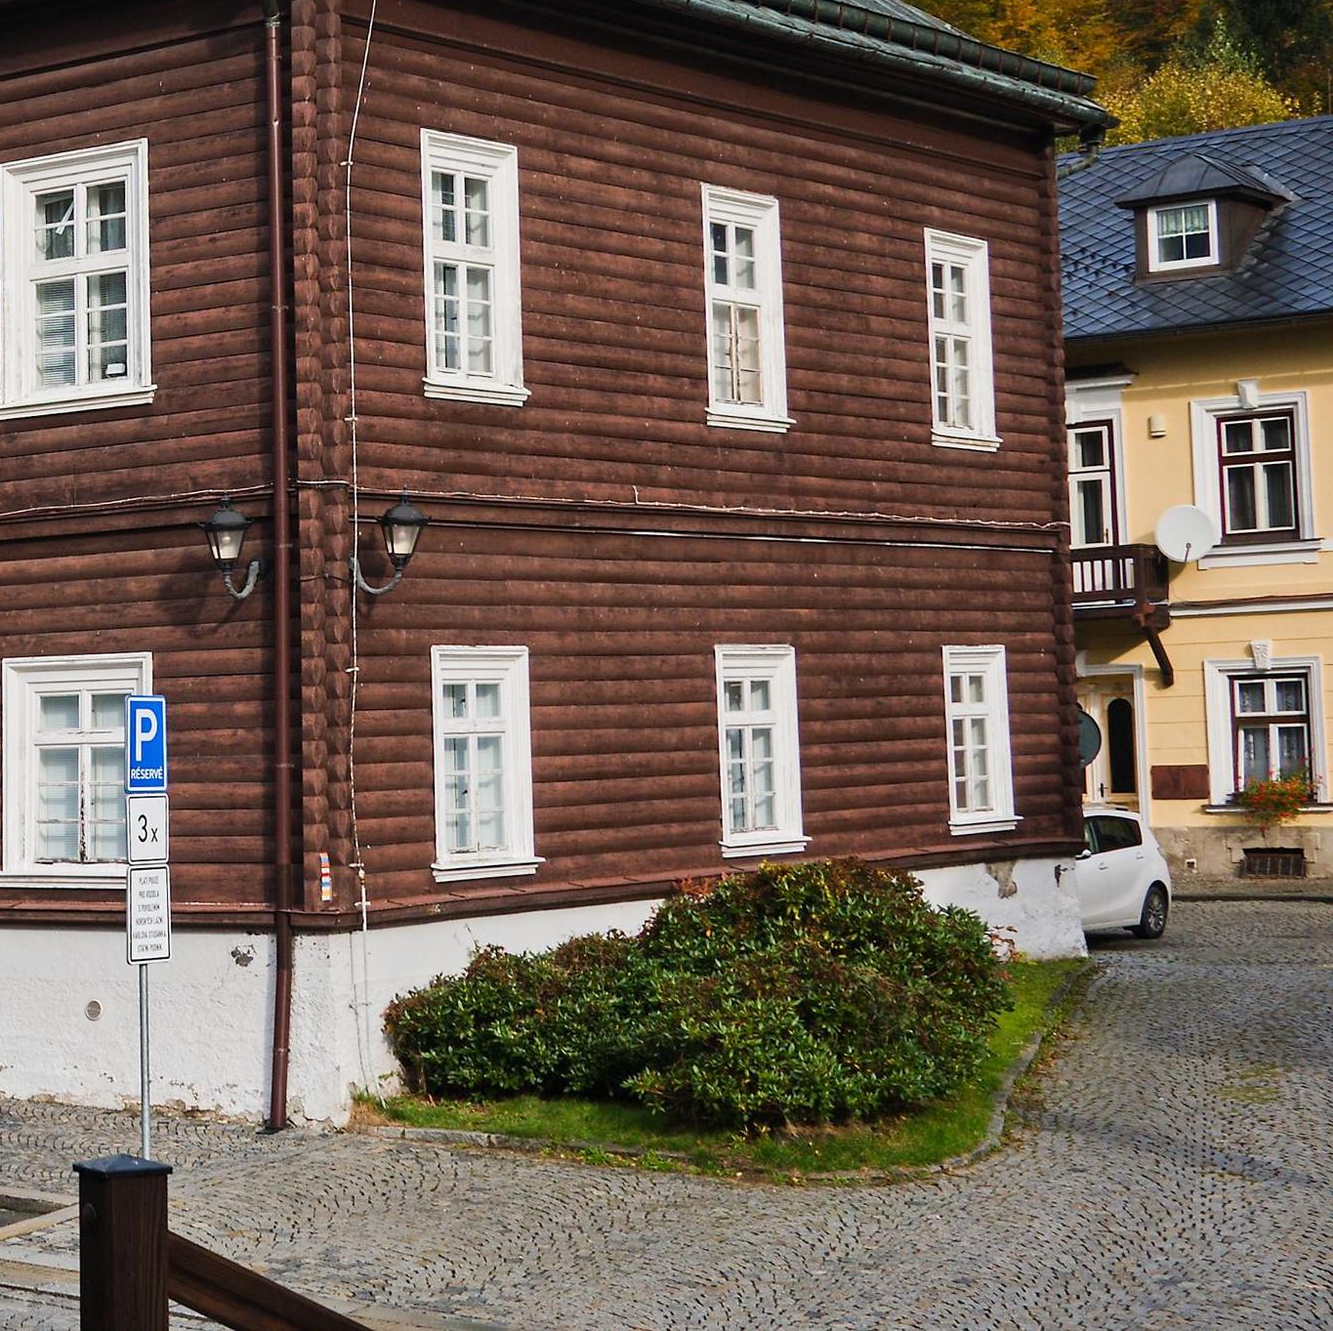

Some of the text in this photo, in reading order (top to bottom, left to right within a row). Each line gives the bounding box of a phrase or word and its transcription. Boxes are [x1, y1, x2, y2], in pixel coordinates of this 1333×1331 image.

[136, 709, 158, 761] P
[131, 766, 164, 780] RÉSERVÉ
[138, 814, 148, 843] 3
